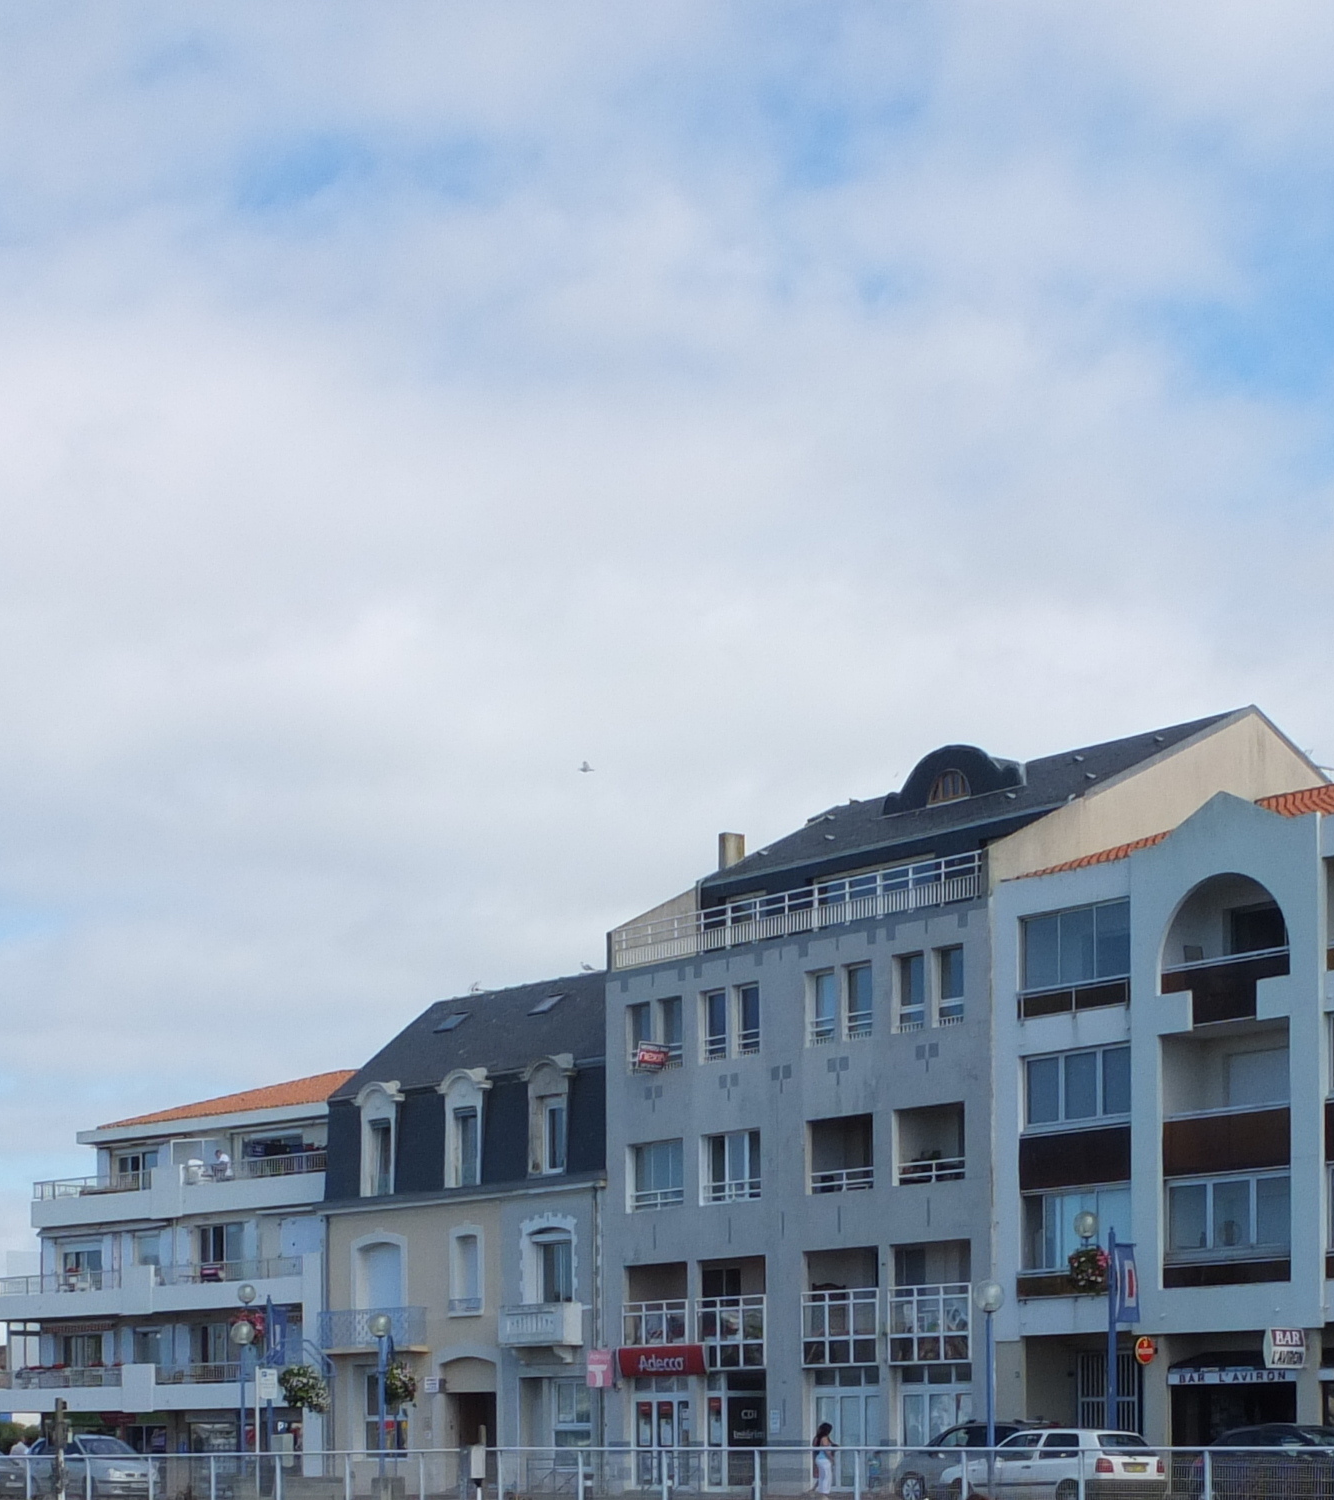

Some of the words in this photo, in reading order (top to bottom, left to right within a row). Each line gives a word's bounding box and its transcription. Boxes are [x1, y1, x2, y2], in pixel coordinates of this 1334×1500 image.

[1274, 1330, 1301, 1345] BAR
[639, 1354, 685, 1372] Adecco
[1179, 1373, 1205, 1384] BAR
[1218, 1370, 1287, 1383] L'AVIRON
